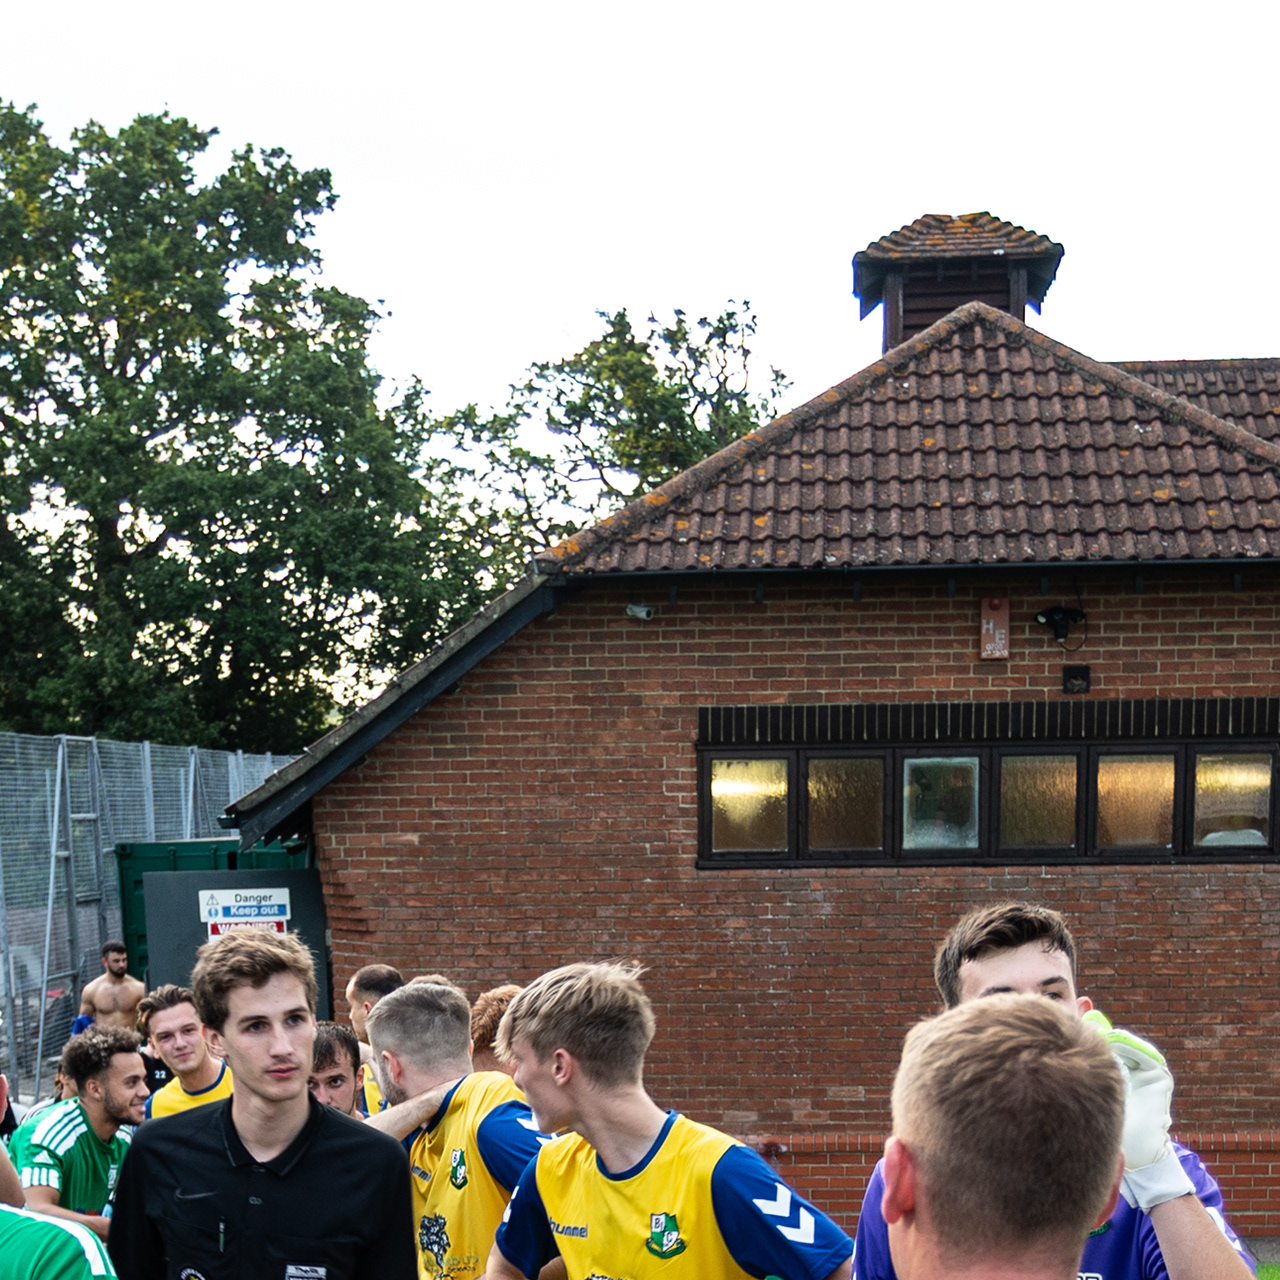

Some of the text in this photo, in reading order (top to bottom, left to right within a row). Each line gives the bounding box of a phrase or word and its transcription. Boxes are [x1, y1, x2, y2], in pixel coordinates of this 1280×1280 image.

[234, 893, 273, 904] Danger
[230, 905, 279, 917] Keep out
[154, 1069, 167, 1079] 22
